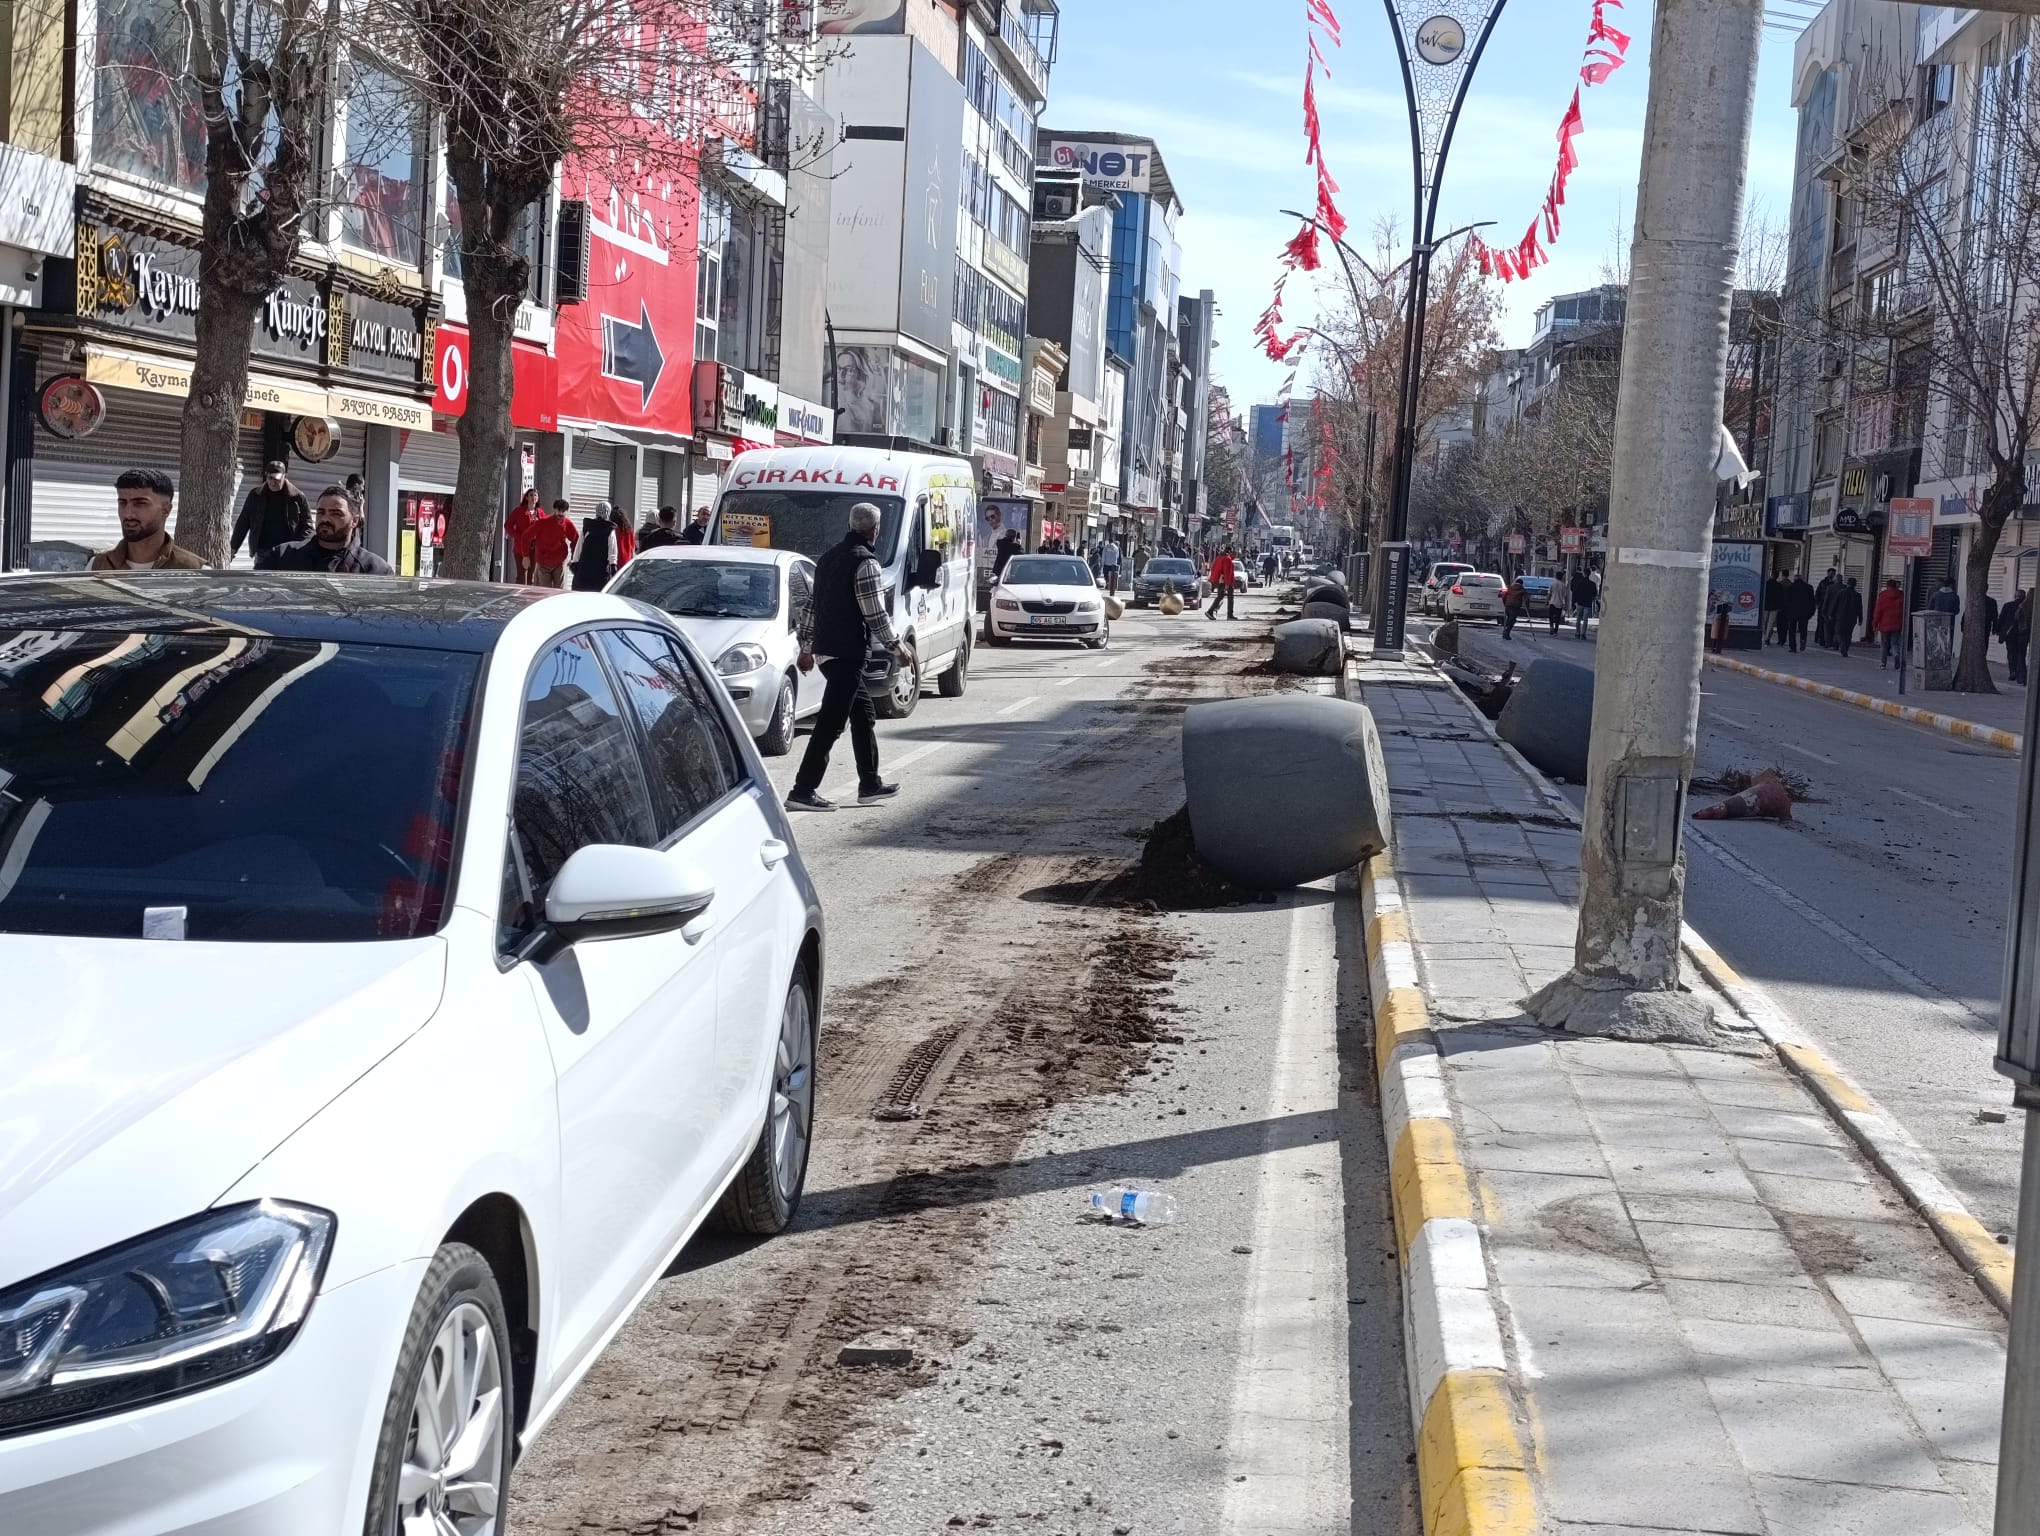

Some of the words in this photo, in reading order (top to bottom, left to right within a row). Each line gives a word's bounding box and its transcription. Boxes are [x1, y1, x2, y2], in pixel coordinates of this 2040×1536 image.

[1089, 179, 1130, 189] MERKEZİ
[21, 196, 41, 217] Van
[265, 287, 327, 346] Künefe
[353, 319, 386, 352] AKYOL
[390, 327, 421, 359] PASAJI
[136, 366, 192, 388] Kayma
[246, 385, 280, 403] ünefe
[340, 398, 380, 417] AKYOL
[735, 468, 900, 492] ÇIRAKLAR
